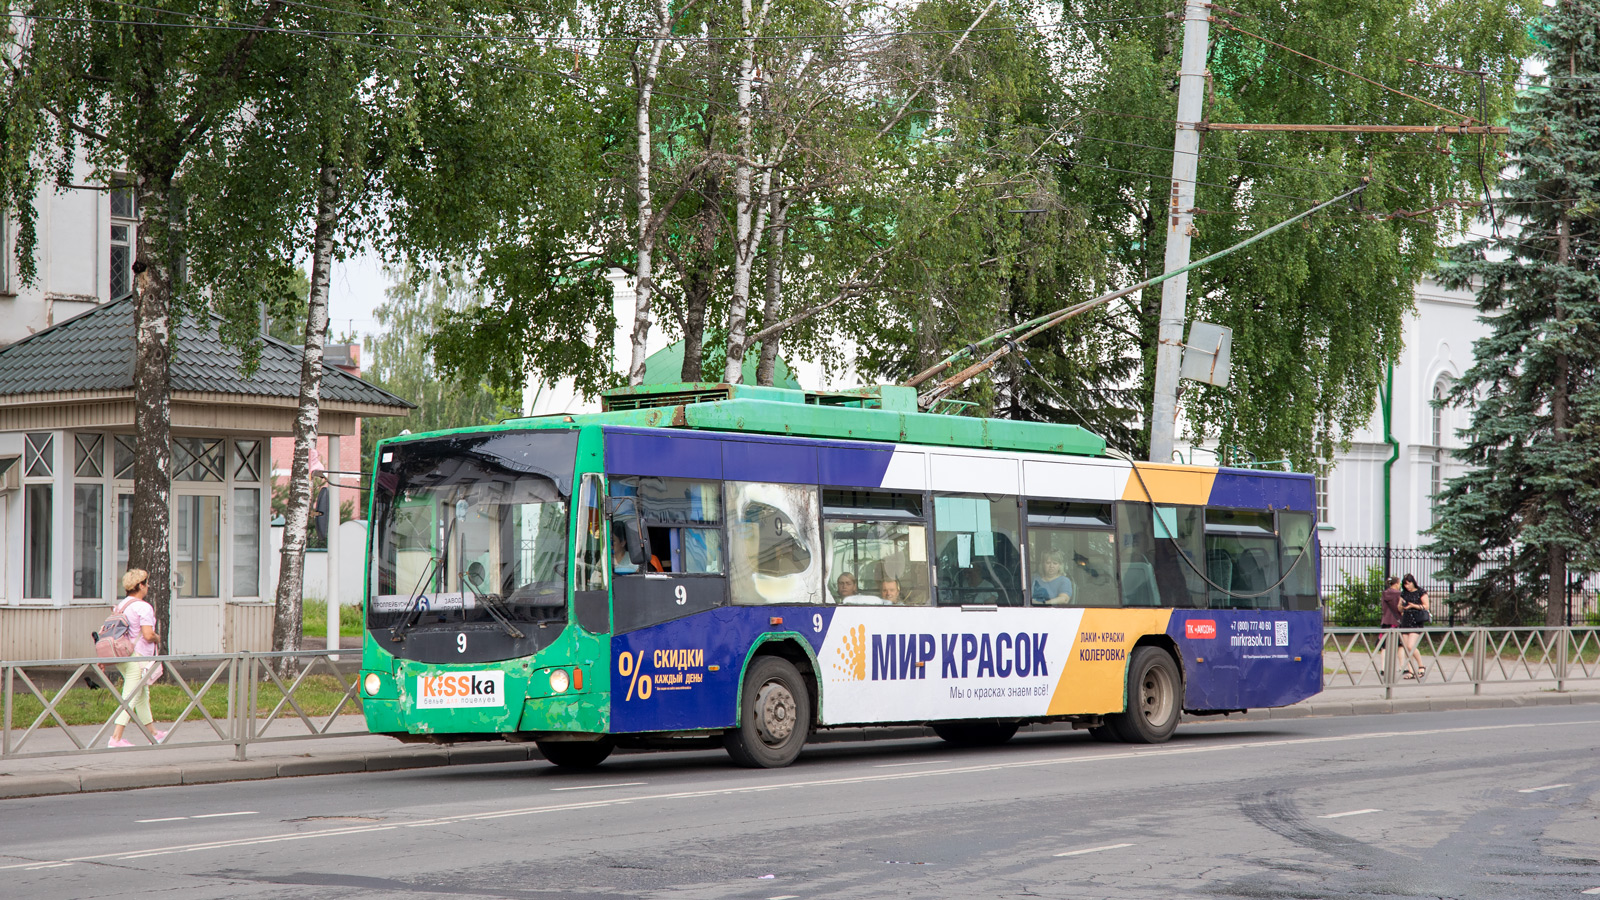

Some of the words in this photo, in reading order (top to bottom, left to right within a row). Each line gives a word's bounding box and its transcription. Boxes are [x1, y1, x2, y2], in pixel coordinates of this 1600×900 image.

[674, 585, 687, 605] 9
[418, 597, 427, 611] 6
[812, 613, 823, 633] 9
[1187, 625, 1194, 634] ТК
[1230, 621, 1237, 630] +7
[1237, 621, 1249, 632] (800)
[1250, 621, 1259, 630] 777
[1259, 621, 1265, 630] 40
[456, 632, 467, 654] 9
[1080, 632, 1097, 643] ЛАКИ
[1101, 632, 1125, 643] КРАСКИ
[1230, 633, 1272, 647] mirkrasok.ru
[653, 649, 704, 671] СКИДКИ
[871, 633, 936, 681] МИР
[941, 632, 1049, 679] КРАСОК
[1080, 648, 1125, 661] КОЛЕРОВКА
[654, 672, 683, 685] КАЖДЫЙ
[950, 686, 965, 699] Мы
[966, 688, 972, 698] о
[974, 687, 1005, 700] красках
[1007, 687, 1032, 697] знаем
[1034, 684, 1049, 697] всё!
